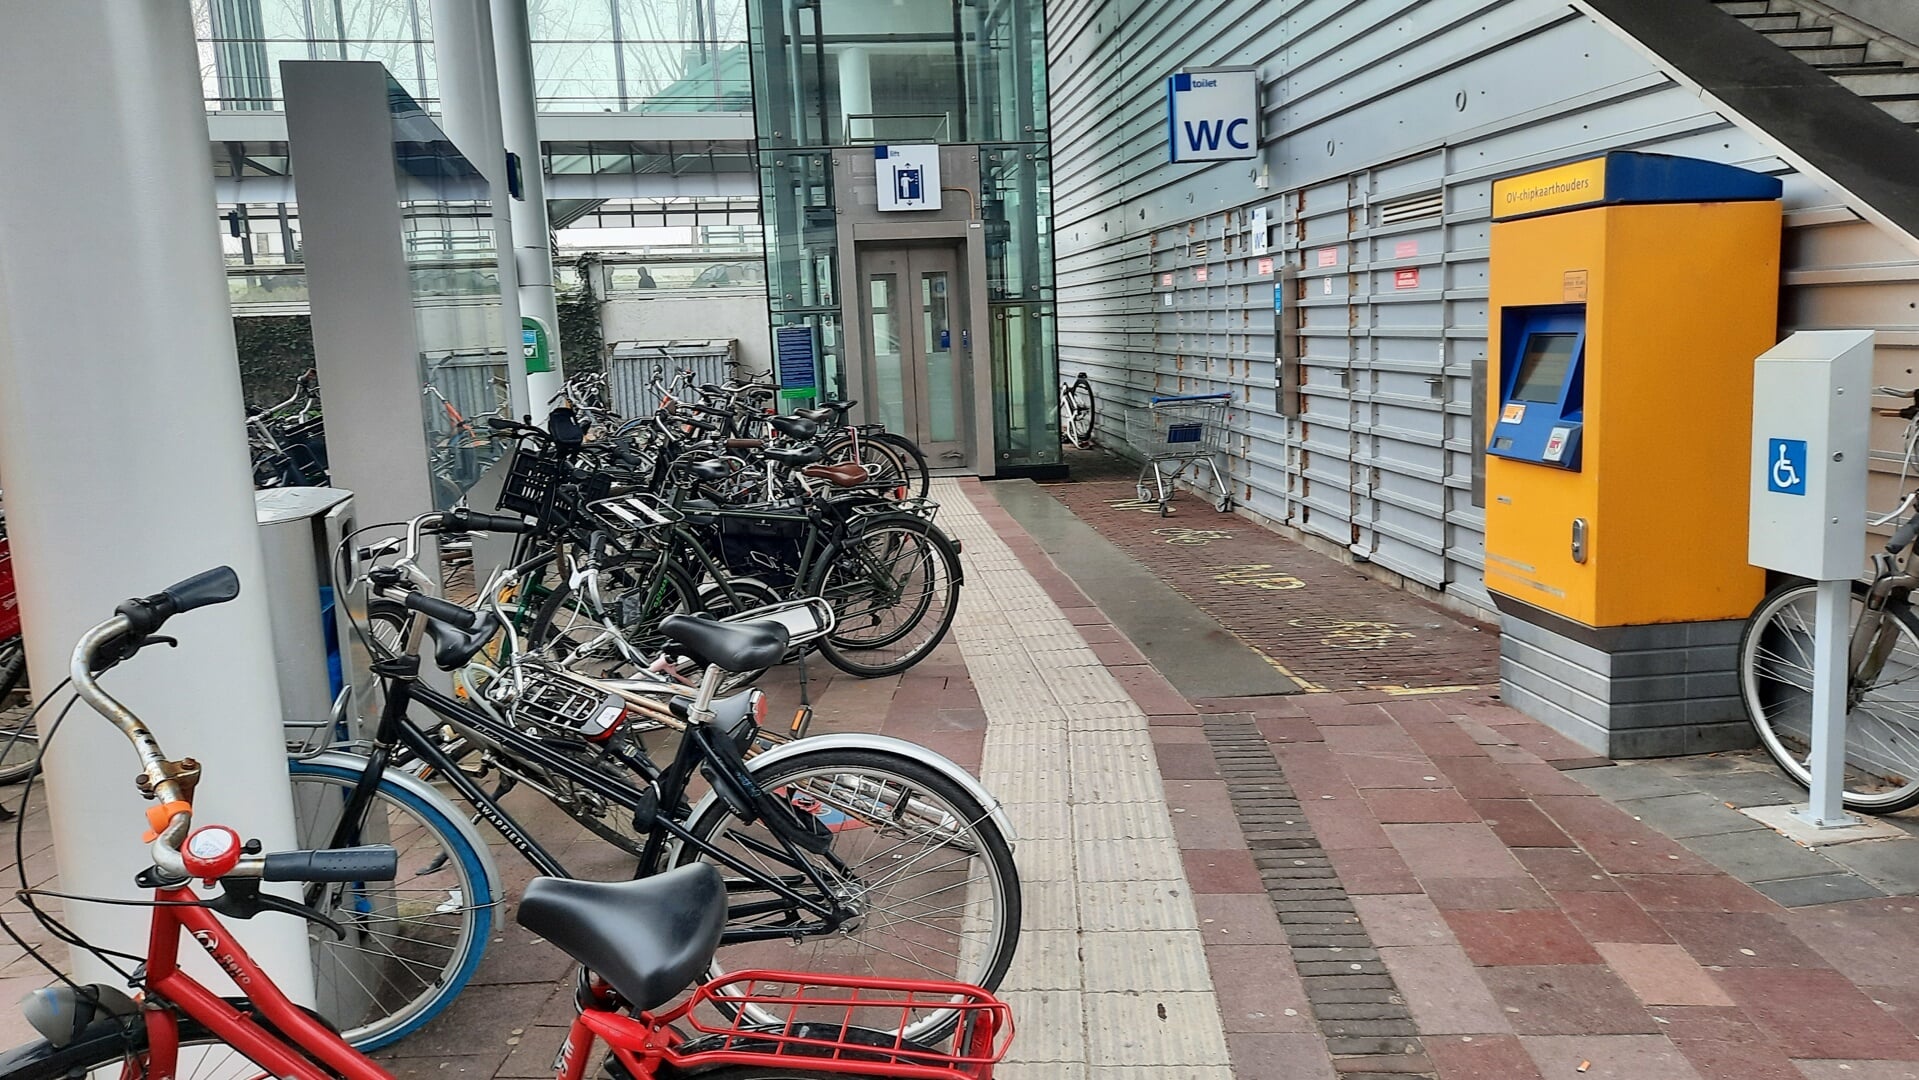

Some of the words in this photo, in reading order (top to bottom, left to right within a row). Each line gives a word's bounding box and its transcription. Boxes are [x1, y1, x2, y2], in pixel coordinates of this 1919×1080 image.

[1192, 79, 1217, 88] toilet
[1184, 117, 1249, 151] WC
[1506, 178, 1589, 203] OV-chipkaarthouders
[475, 801, 528, 850] SWAPFIETS
[222, 953, 251, 985] Retro
